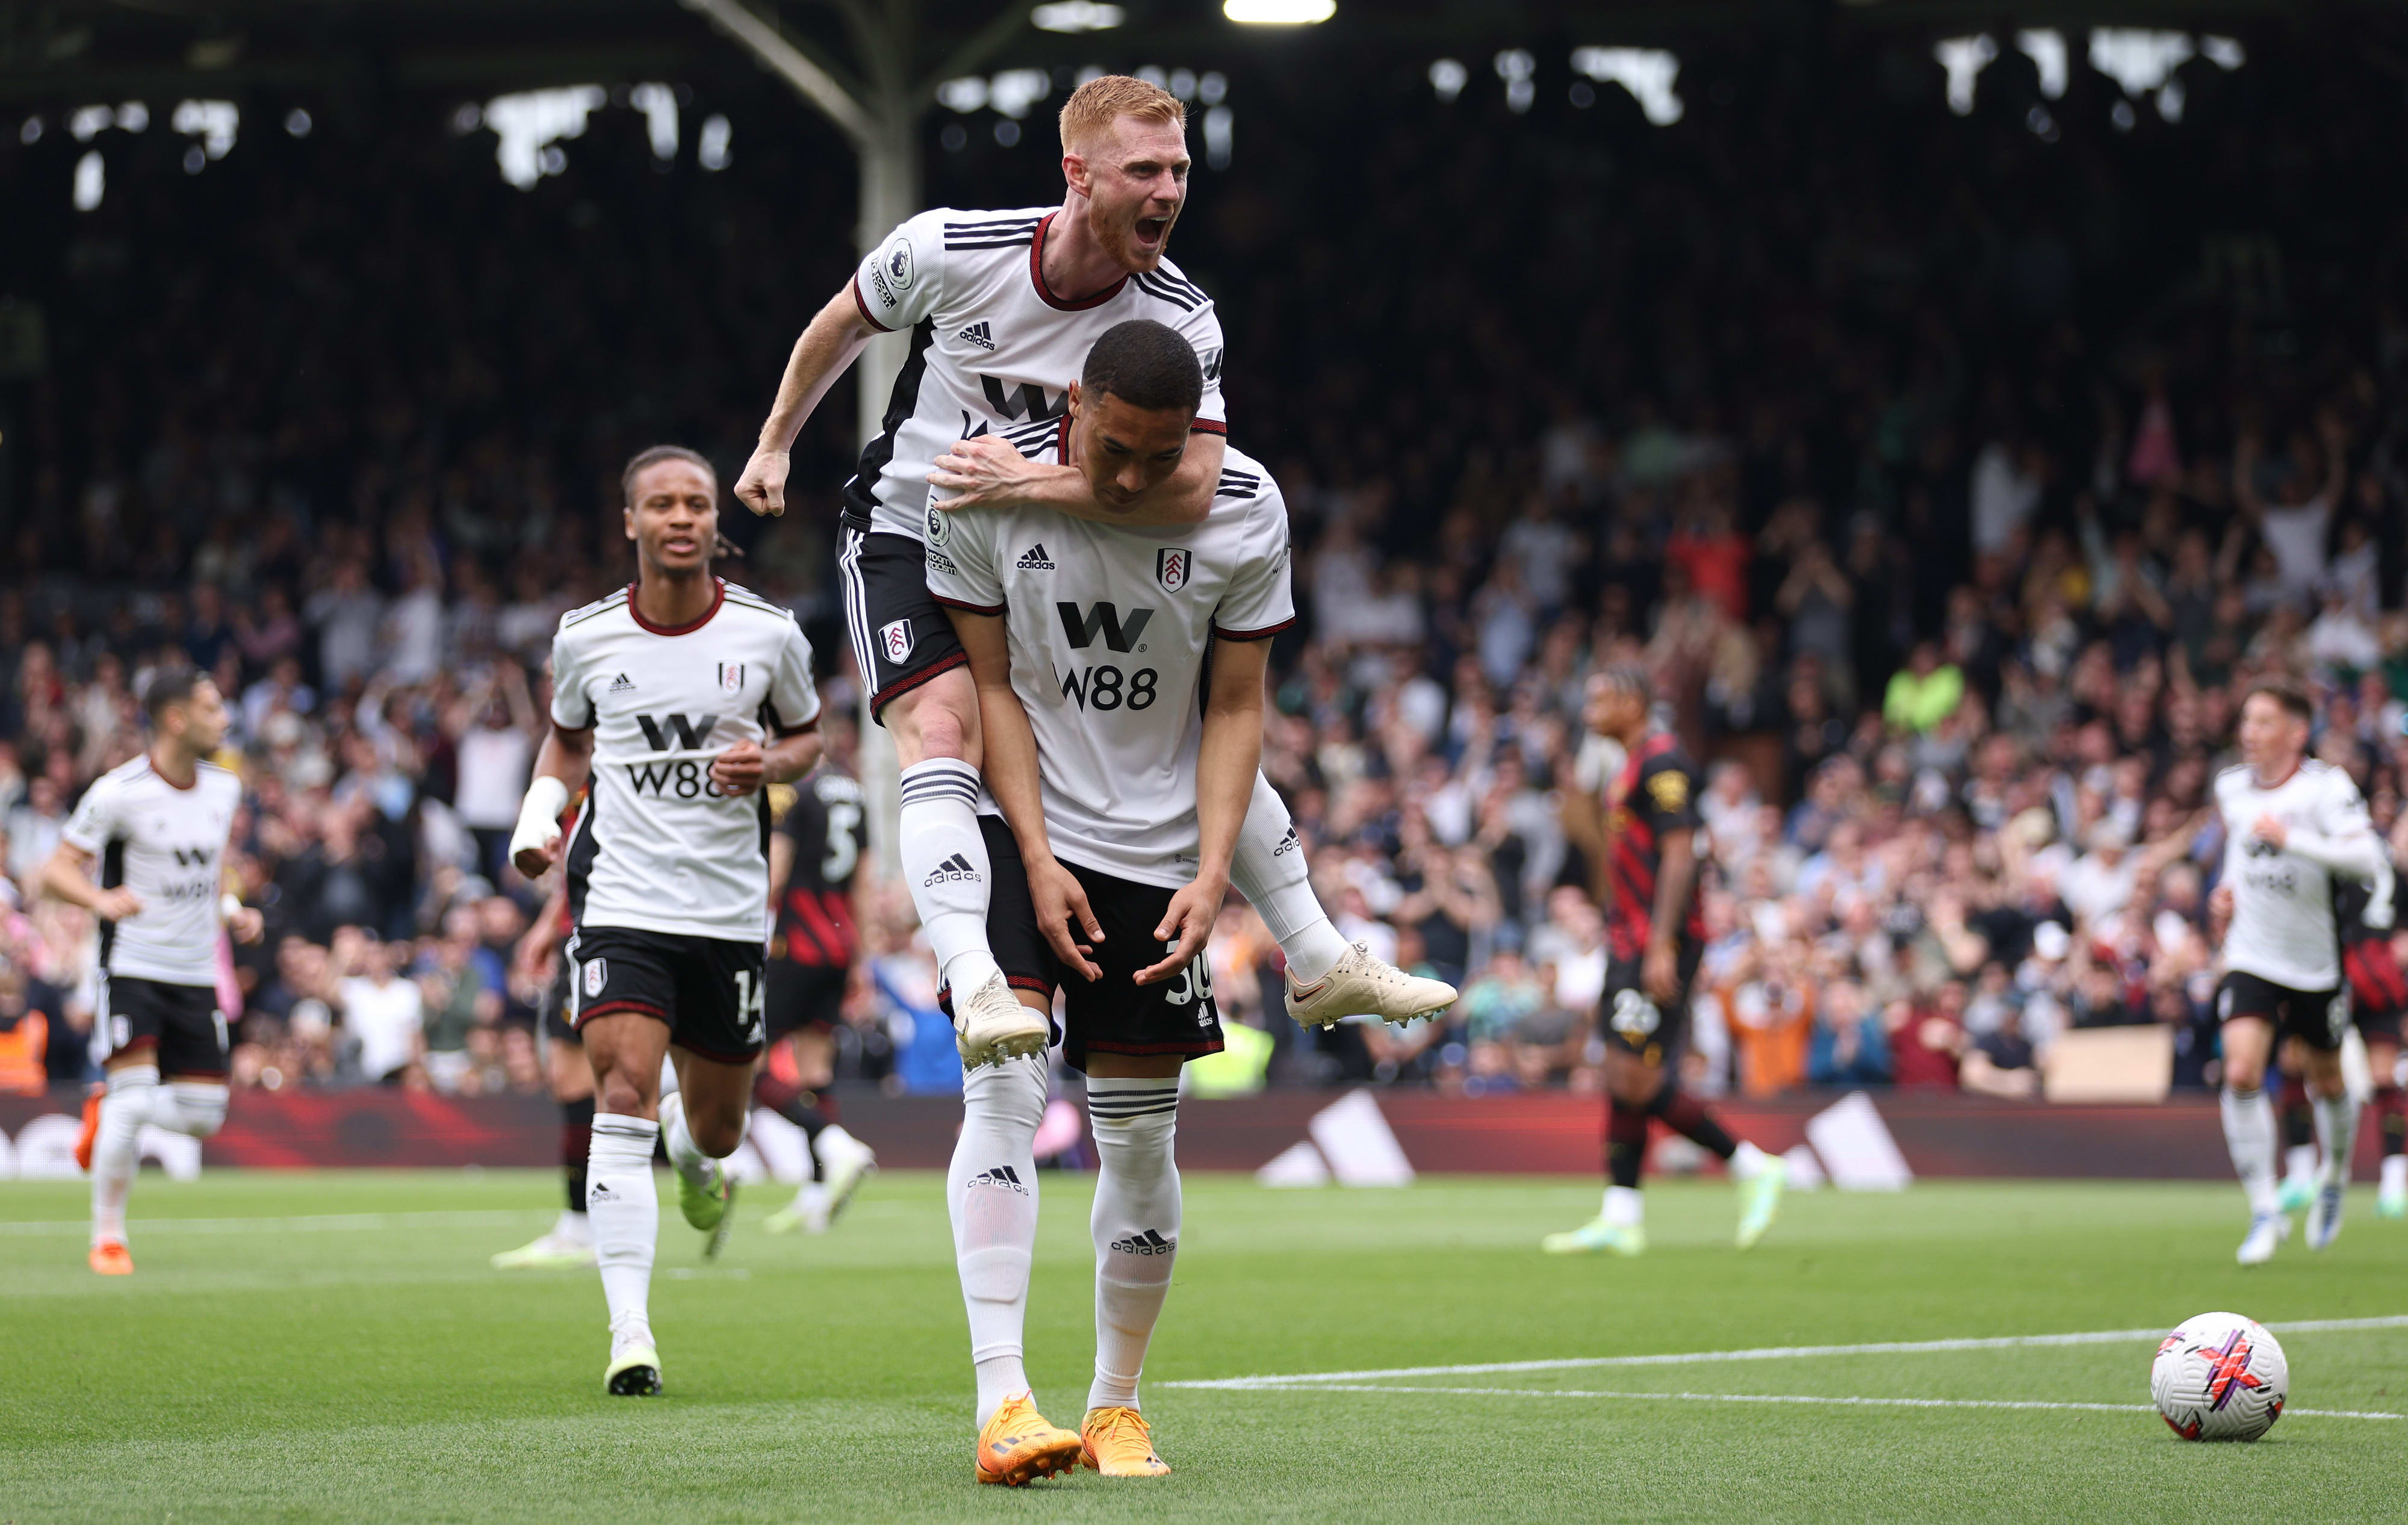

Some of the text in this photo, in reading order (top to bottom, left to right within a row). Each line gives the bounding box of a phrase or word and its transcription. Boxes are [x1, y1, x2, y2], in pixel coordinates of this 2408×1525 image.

[876, 273, 892, 301] room
[960, 331, 995, 351] adidas
[929, 551, 951, 567] room
[929, 559, 957, 575] racism
[1016, 559, 1055, 570] adidas
[1165, 553, 1183, 585] FFC
[1056, 601, 1155, 653] W
[888, 627, 905, 656] FFC
[1051, 661, 1158, 714] W88
[821, 802, 861, 883] 5
[924, 870, 981, 887] adidas
[967, 1177, 1029, 1196] adidas
[1111, 1243, 1175, 1255] adidas
